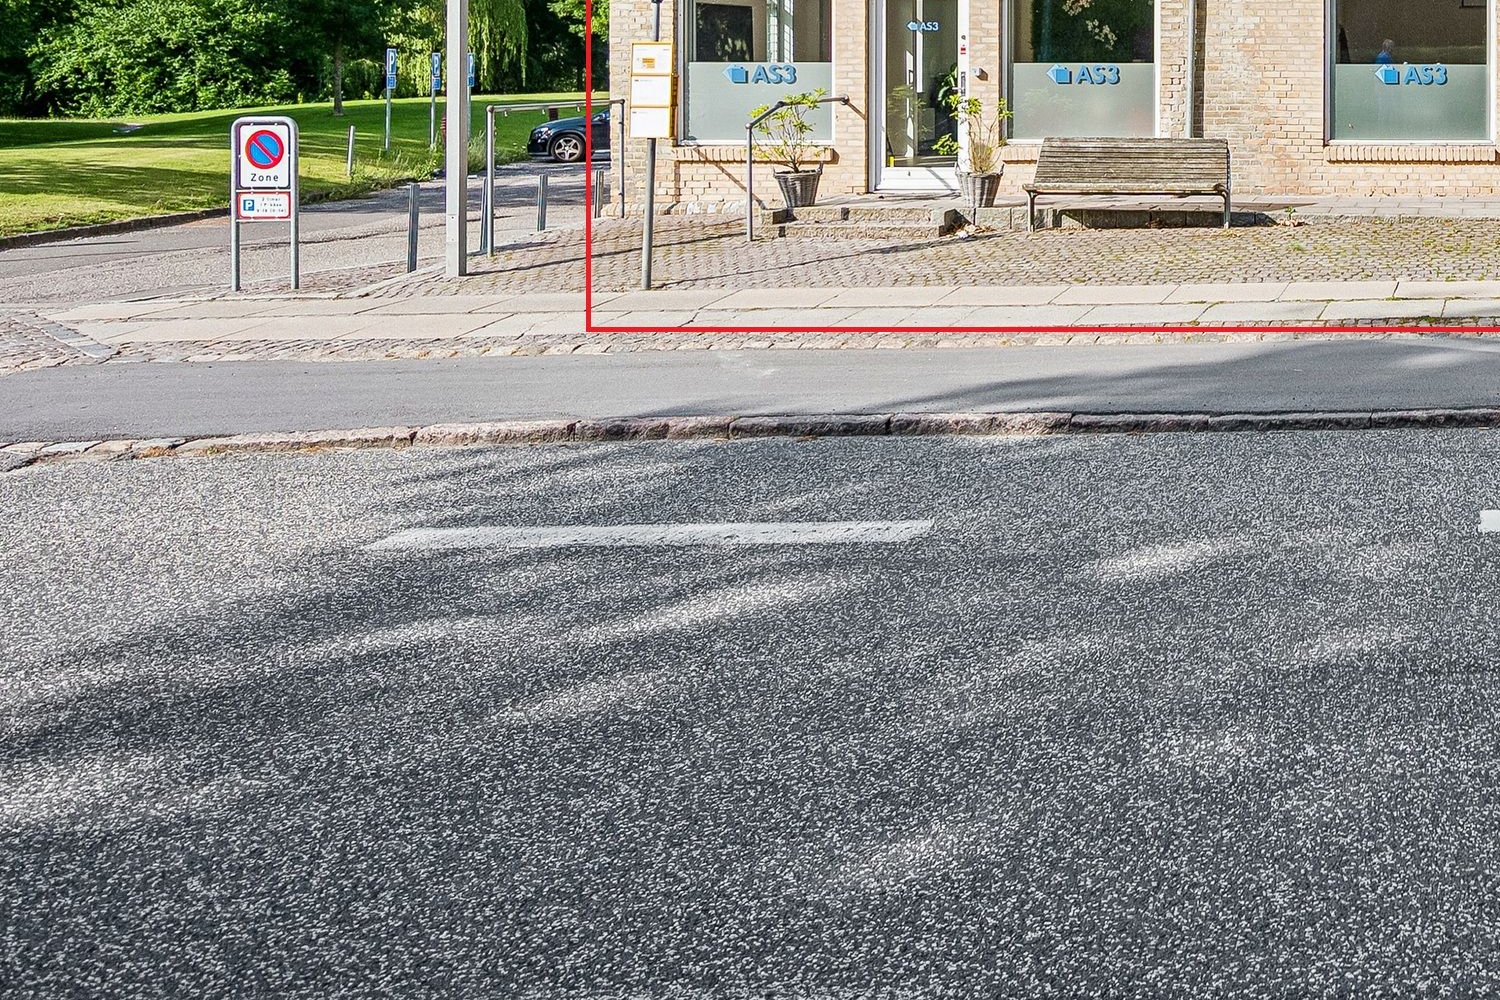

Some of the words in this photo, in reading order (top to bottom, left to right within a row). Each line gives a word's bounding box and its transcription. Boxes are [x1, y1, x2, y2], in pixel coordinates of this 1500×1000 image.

[920, 21, 939, 31] AS3
[751, 64, 798, 84] AS3
[1075, 64, 1121, 84] AS3
[1404, 66, 1449, 86] AS3
[250, 173, 279, 182] Zone
